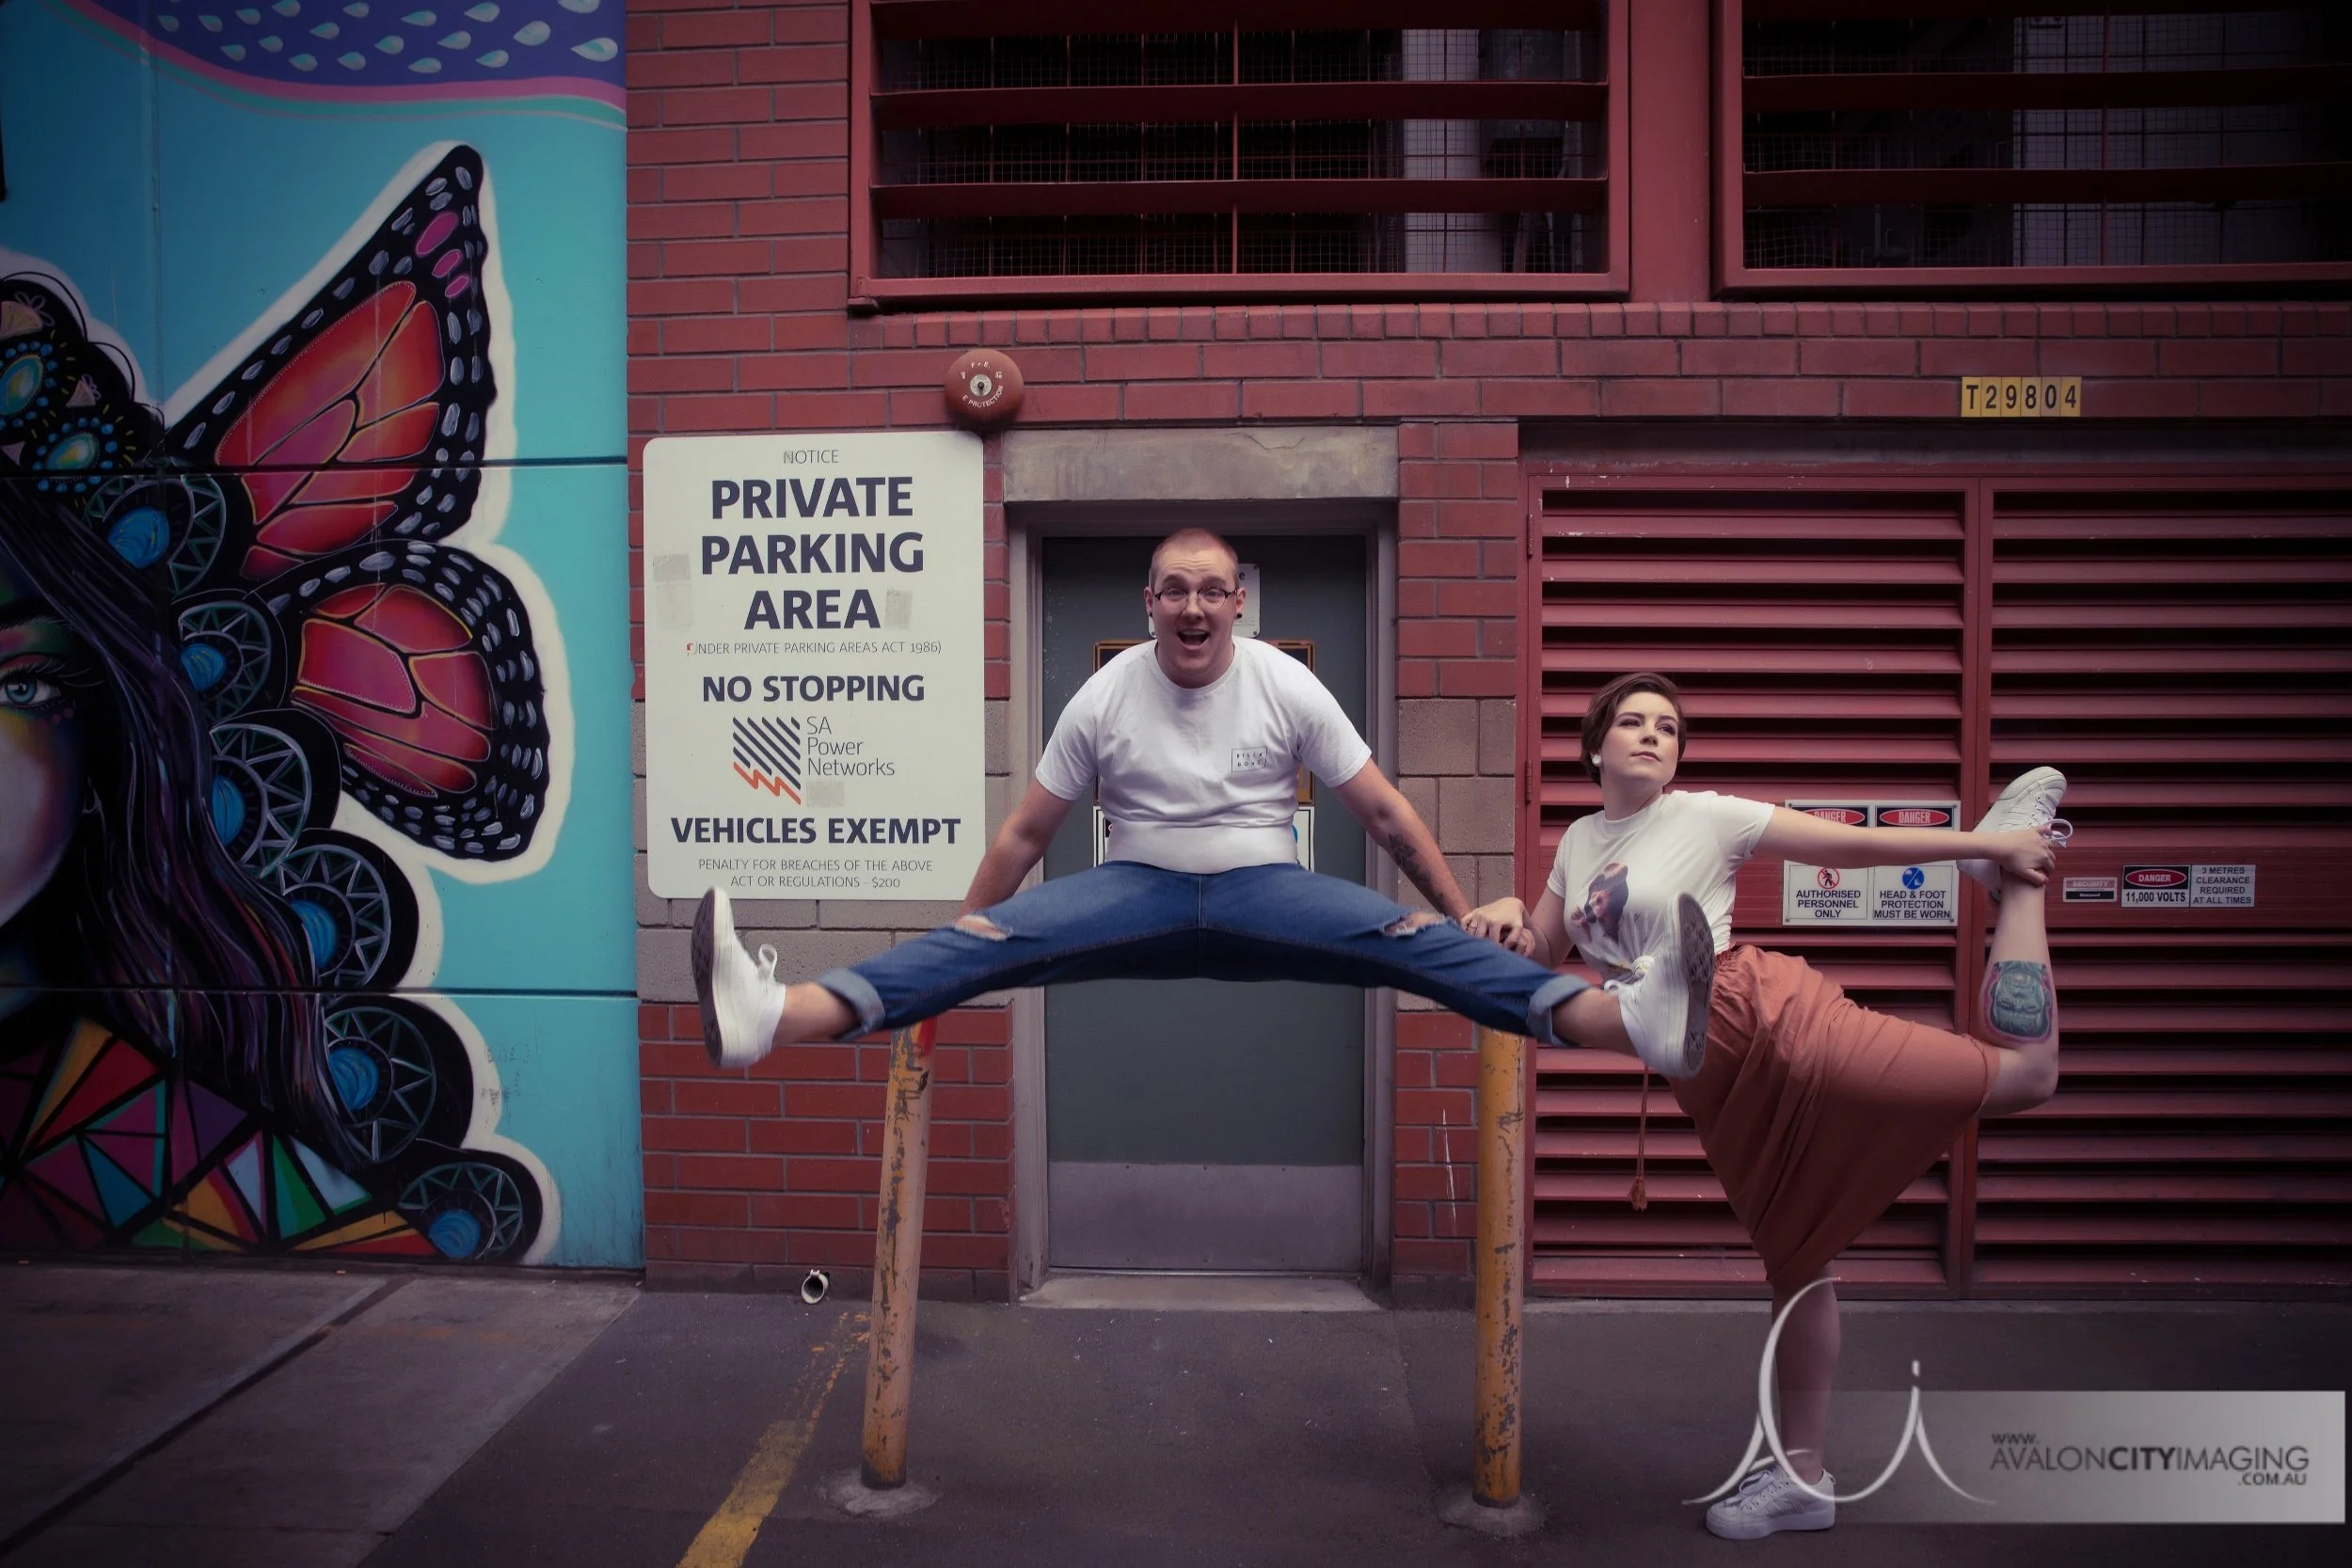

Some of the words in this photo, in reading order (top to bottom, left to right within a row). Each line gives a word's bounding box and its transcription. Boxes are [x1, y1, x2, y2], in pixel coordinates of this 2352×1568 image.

[1965, 384, 2076, 409] T29804
[783, 450, 839, 464] NOTICE
[712, 477, 913, 519] PRIVATE
[702, 531, 923, 575] PARKING
[744, 589, 881, 629] AREA
[734, 642, 780, 655] PRIVATE
[784, 641, 835, 654] PARKING
[839, 641, 878, 654] AREAS
[882, 641, 905, 653] ACT
[910, 641, 942, 655] 1986)
[703, 676, 752, 702] NO
[763, 674, 925, 702] STOPPING
[806, 717, 832, 735] SA
[807, 737, 863, 755] Power
[808, 758, 895, 776] Networks
[1899, 811, 1931, 824] DANGER
[671, 817, 817, 844] VEHICLES
[828, 817, 961, 845] EXEMPT
[698, 859, 749, 871] PENALTY
[753, 859, 776, 871] FOR
[781, 859, 840, 871] BREACHES
[844, 860, 861, 871] OF
[865, 860, 888, 872] THE
[892, 860, 933, 872] ABOVE
[2210, 866, 2246, 875] METRES
[730, 875, 754, 887] ACT
[757, 876, 775, 887] OR
[779, 876, 861, 888] REGULATIONS
[871, 876, 900, 889] $200
[2137, 874, 2171, 882] DANGER
[2196, 876, 2250, 885] CLEARANCE
[1795, 890, 1861, 899] AUTHORISED
[1879, 890, 1907, 899] HEAD
[1910, 890, 1916, 899] &
[1918, 890, 1947, 899] FOOT
[2200, 886, 2246, 895] REQUIRED
[1798, 899, 1859, 909] PERSONNEL
[1881, 900, 1944, 909] PROTECTION
[2125, 892, 2154, 904] 11,000
[2157, 892, 2186, 902] VOLTS
[1815, 910, 1841, 918] ONLY
[1873, 910, 1900, 919] MUST
[1904, 910, 1917, 919] BE
[1920, 910, 1951, 919] WORN
